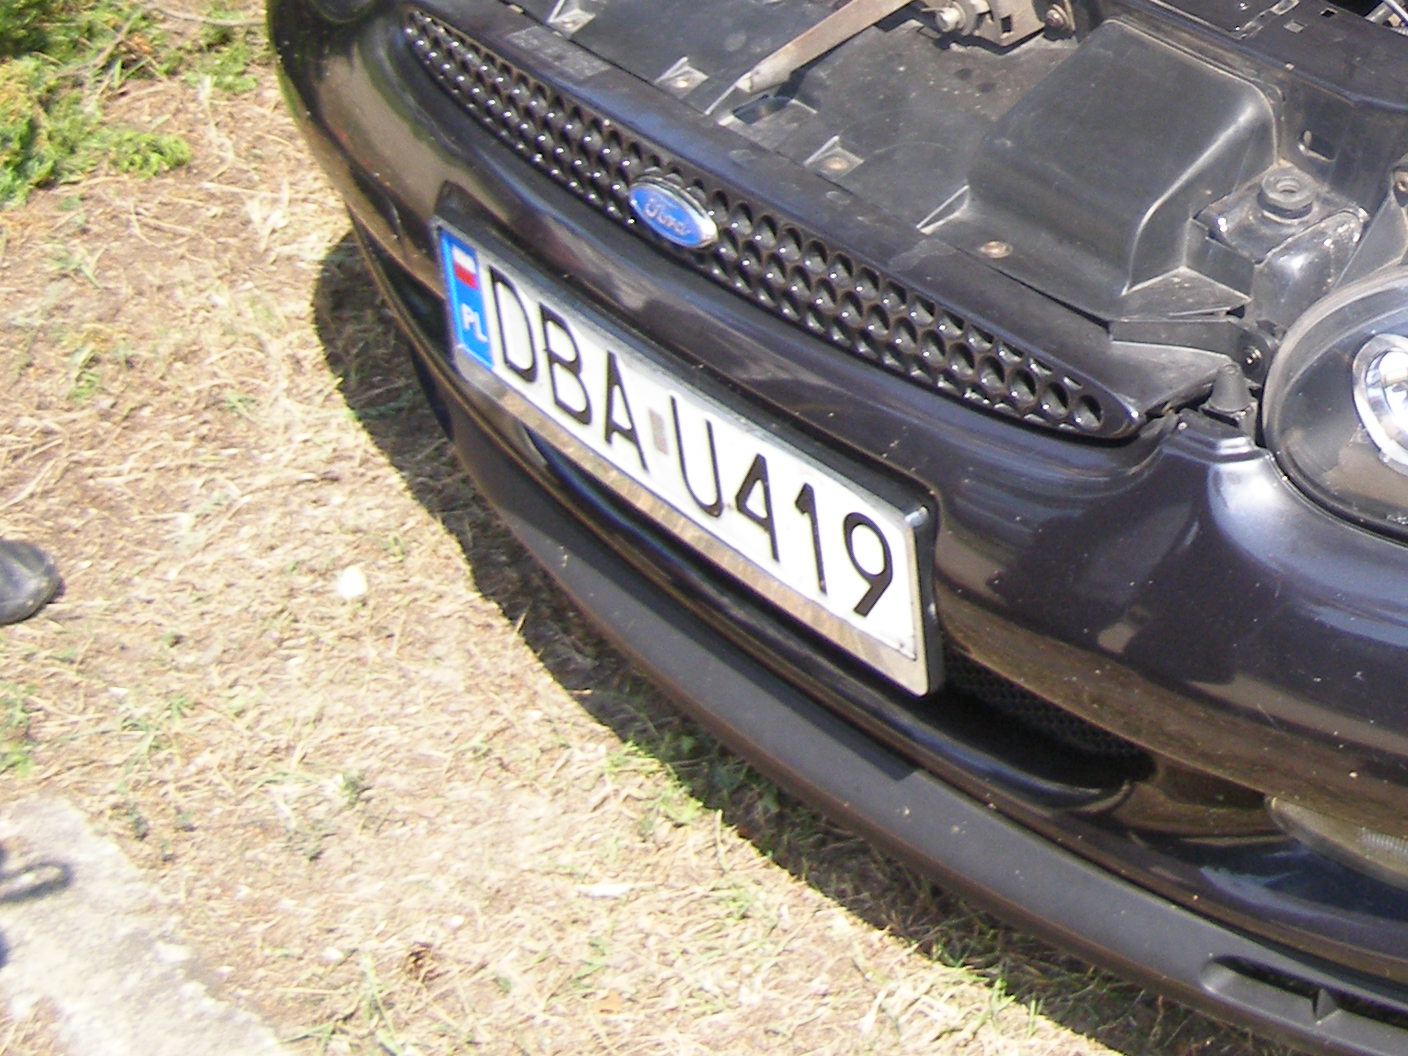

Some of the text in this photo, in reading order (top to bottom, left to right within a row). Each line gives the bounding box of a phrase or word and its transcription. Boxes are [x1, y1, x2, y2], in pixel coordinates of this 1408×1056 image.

[644, 194, 691, 236] Ford
[461, 302, 488, 343] PL
[489, 264, 893, 618] DBA U419
